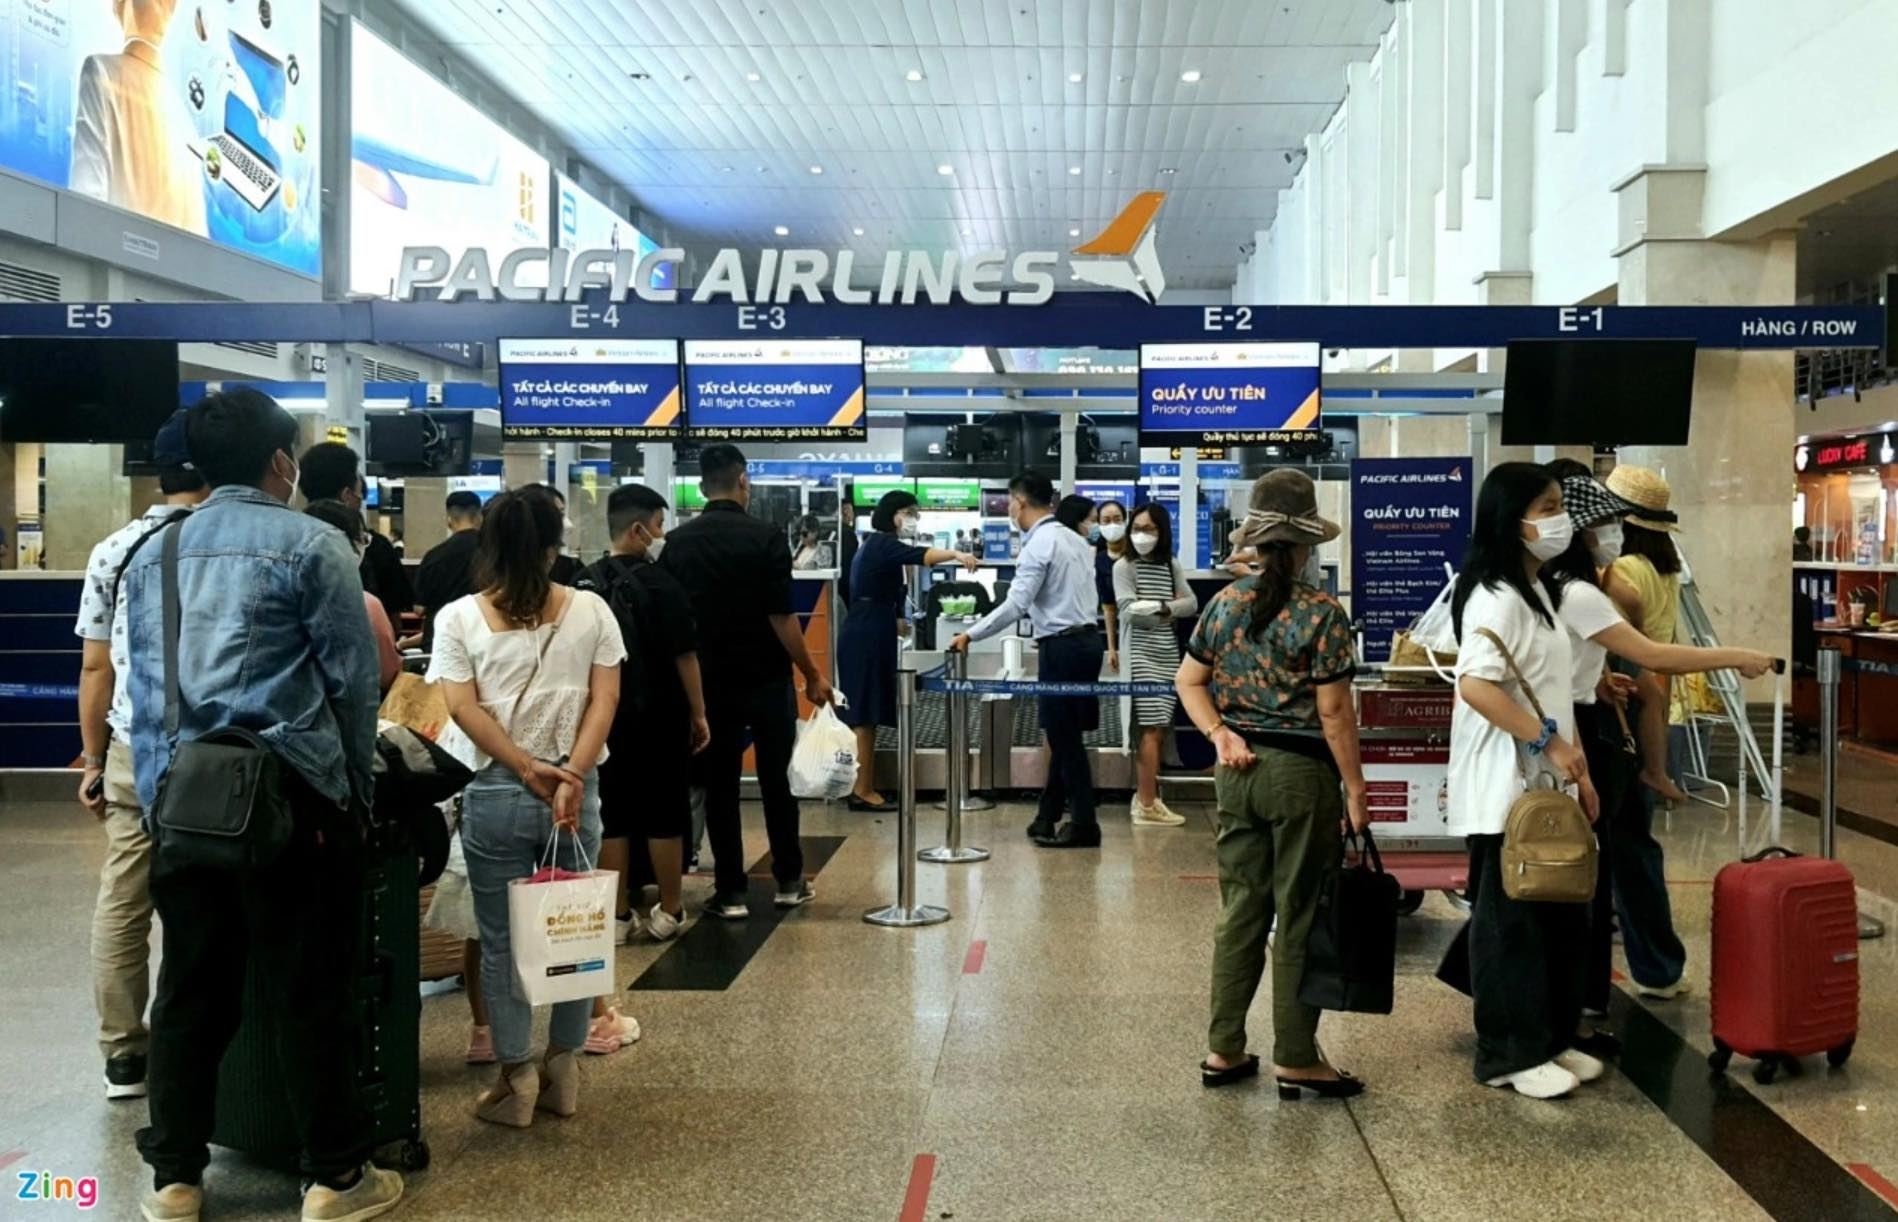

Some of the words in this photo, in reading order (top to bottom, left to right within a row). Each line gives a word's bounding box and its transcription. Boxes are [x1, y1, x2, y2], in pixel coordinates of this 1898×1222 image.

[397, 246, 684, 302] PACIFIC
[691, 248, 1060, 305] AIRLINES
[67, 304, 112, 328] E-5
[570, 305, 620, 328] E-4
[737, 306, 787, 330] E-3
[1204, 306, 1252, 330] E-2
[1558, 307, 1603, 331] E-1
[1742, 318, 1797, 336] HÀNG
[1800, 321, 1808, 335] /
[1813, 320, 1858, 336] ROW
[512, 379, 534, 393] TẤT
[553, 381, 577, 393] CÁC
[625, 383, 649, 394] BAY
[697, 381, 719, 394] TẤT
[738, 382, 762, 394] CÁC
[809, 384, 833, 395] BAY
[1202, 386, 1225, 400] ƯU
[1230, 384, 1266, 400] TIÊN
[513, 396, 529, 406] All
[531, 396, 559, 408] flight
[562, 396, 612, 407] Check-in
[699, 398, 714, 408] All
[716, 397, 744, 409] flight
[747, 397, 796, 408] Check-in
[1152, 404, 1191, 415] Priority
[1195, 405, 1237, 414] counter
[625, 428, 646, 437] mins
[648, 428, 667, 438] prior
[668, 429, 678, 437] to
[1292, 432, 1303, 440] 40
[874, 463, 893, 472] G-4
[1361, 474, 1399, 484] PACIFIC
[1400, 473, 1447, 483] AIRLINES
[1405, 505, 1425, 518] ƯU
[1428, 504, 1459, 518] TIÊN
[1412, 522, 1450, 530] COUNTER
[1857, 659, 1889, 673] TIA
[943, 680, 974, 690] TIA
[1404, 706, 1451, 716] AGRIB
